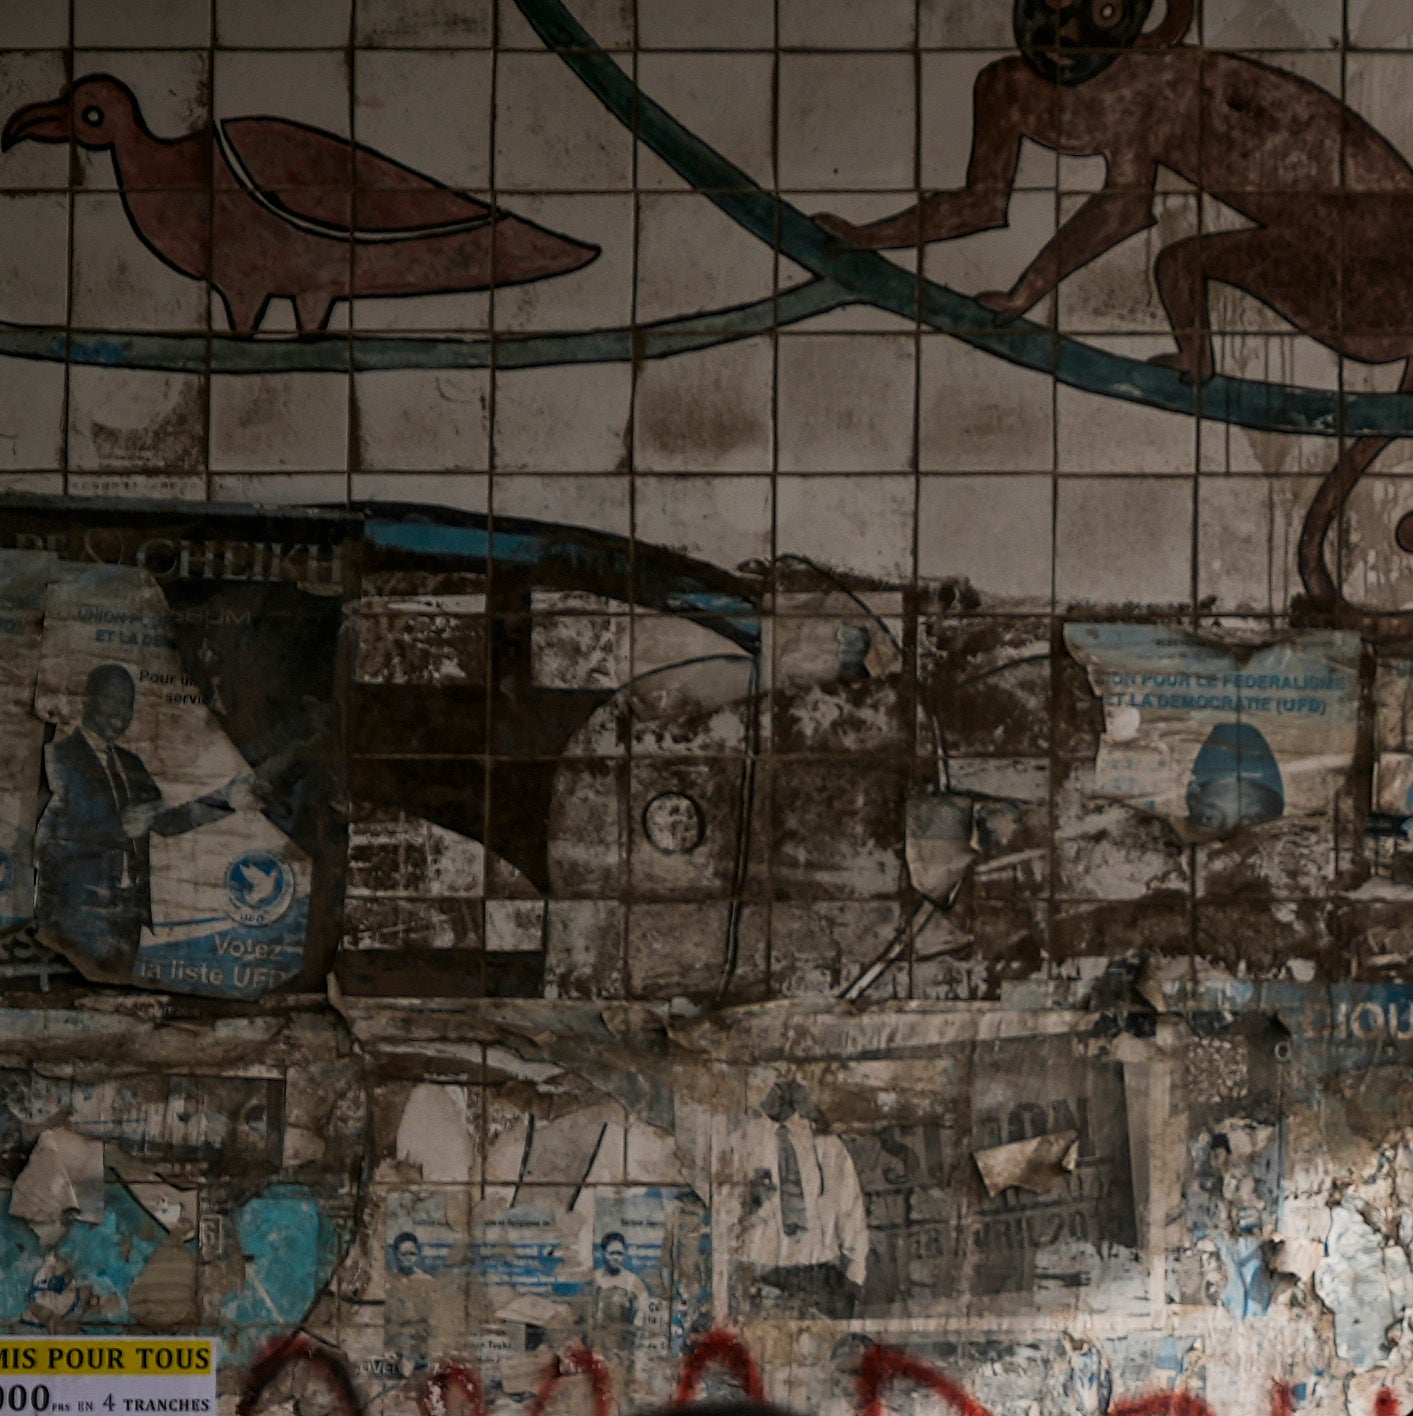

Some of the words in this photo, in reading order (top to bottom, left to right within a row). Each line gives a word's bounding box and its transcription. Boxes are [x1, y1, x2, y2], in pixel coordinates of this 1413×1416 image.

[214, 933, 284, 963] Votez
[170, 958, 225, 986] liste
[48, 1347, 125, 1370] POUR
[136, 1347, 209, 1370] TOUS
[0, 1384, 50, 1412] 00
[102, 1392, 115, 1412] 4
[123, 1398, 210, 1412] TRANCHES
